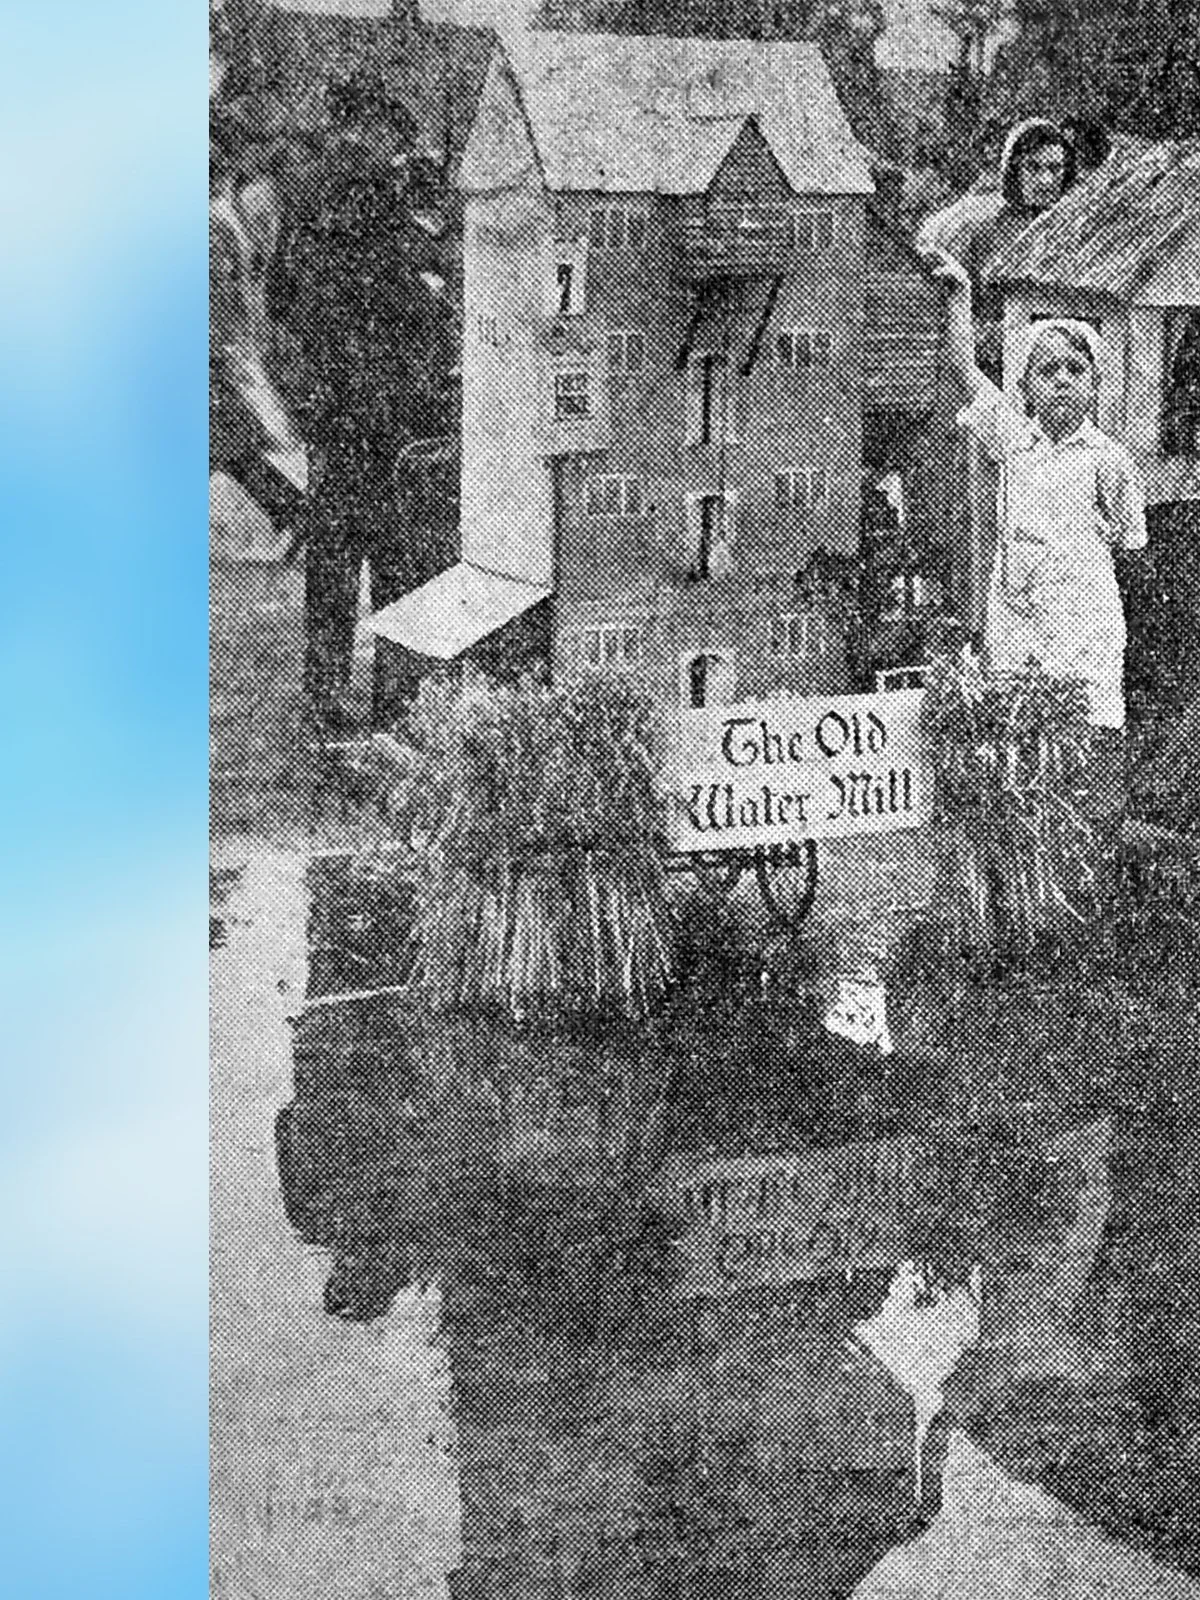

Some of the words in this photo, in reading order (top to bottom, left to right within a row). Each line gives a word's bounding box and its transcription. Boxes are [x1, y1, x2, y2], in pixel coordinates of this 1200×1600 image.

[722, 717, 802, 767] The
[815, 710, 887, 758] Old
[687, 783, 811, 834] Water
[826, 767, 912, 820] Mill
